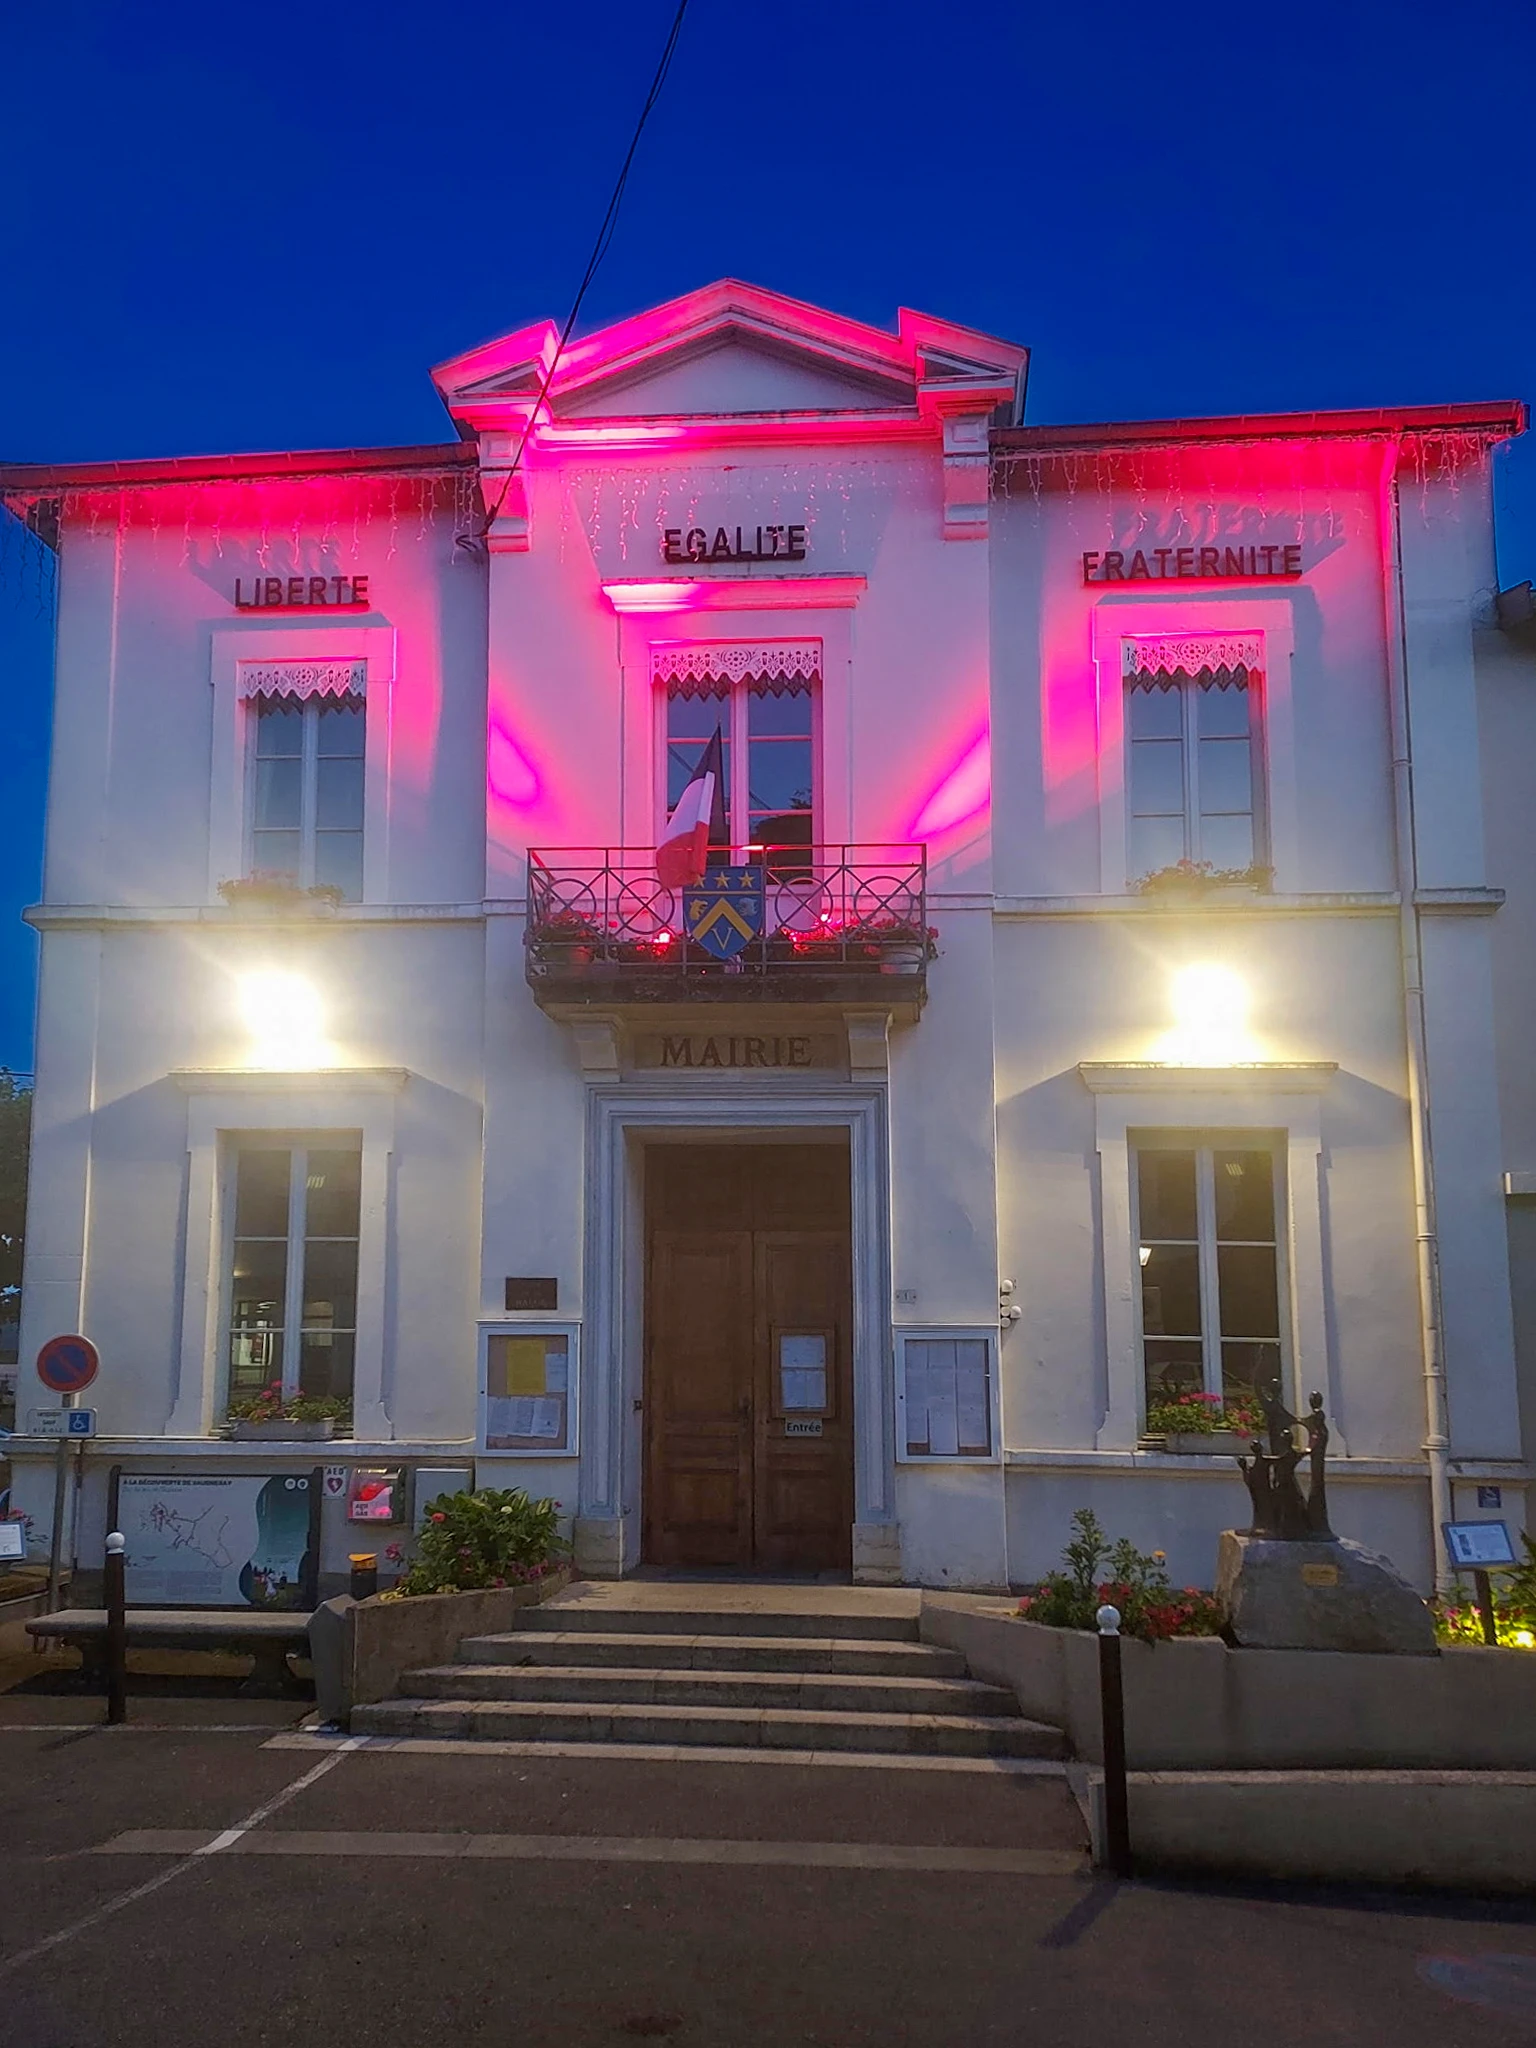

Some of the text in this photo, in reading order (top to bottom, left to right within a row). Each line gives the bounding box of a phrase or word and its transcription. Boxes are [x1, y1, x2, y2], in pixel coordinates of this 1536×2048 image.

[664, 525, 806, 560] EGALITE
[1083, 545, 1303, 582] FRATERNITE
[235, 576, 369, 607] LIBERTE
[711, 927, 734, 950] V
[660, 1036, 813, 1067] MAIRIE
[787, 1421, 822, 1433] Entrée
[326, 1467, 344, 1476] AED
